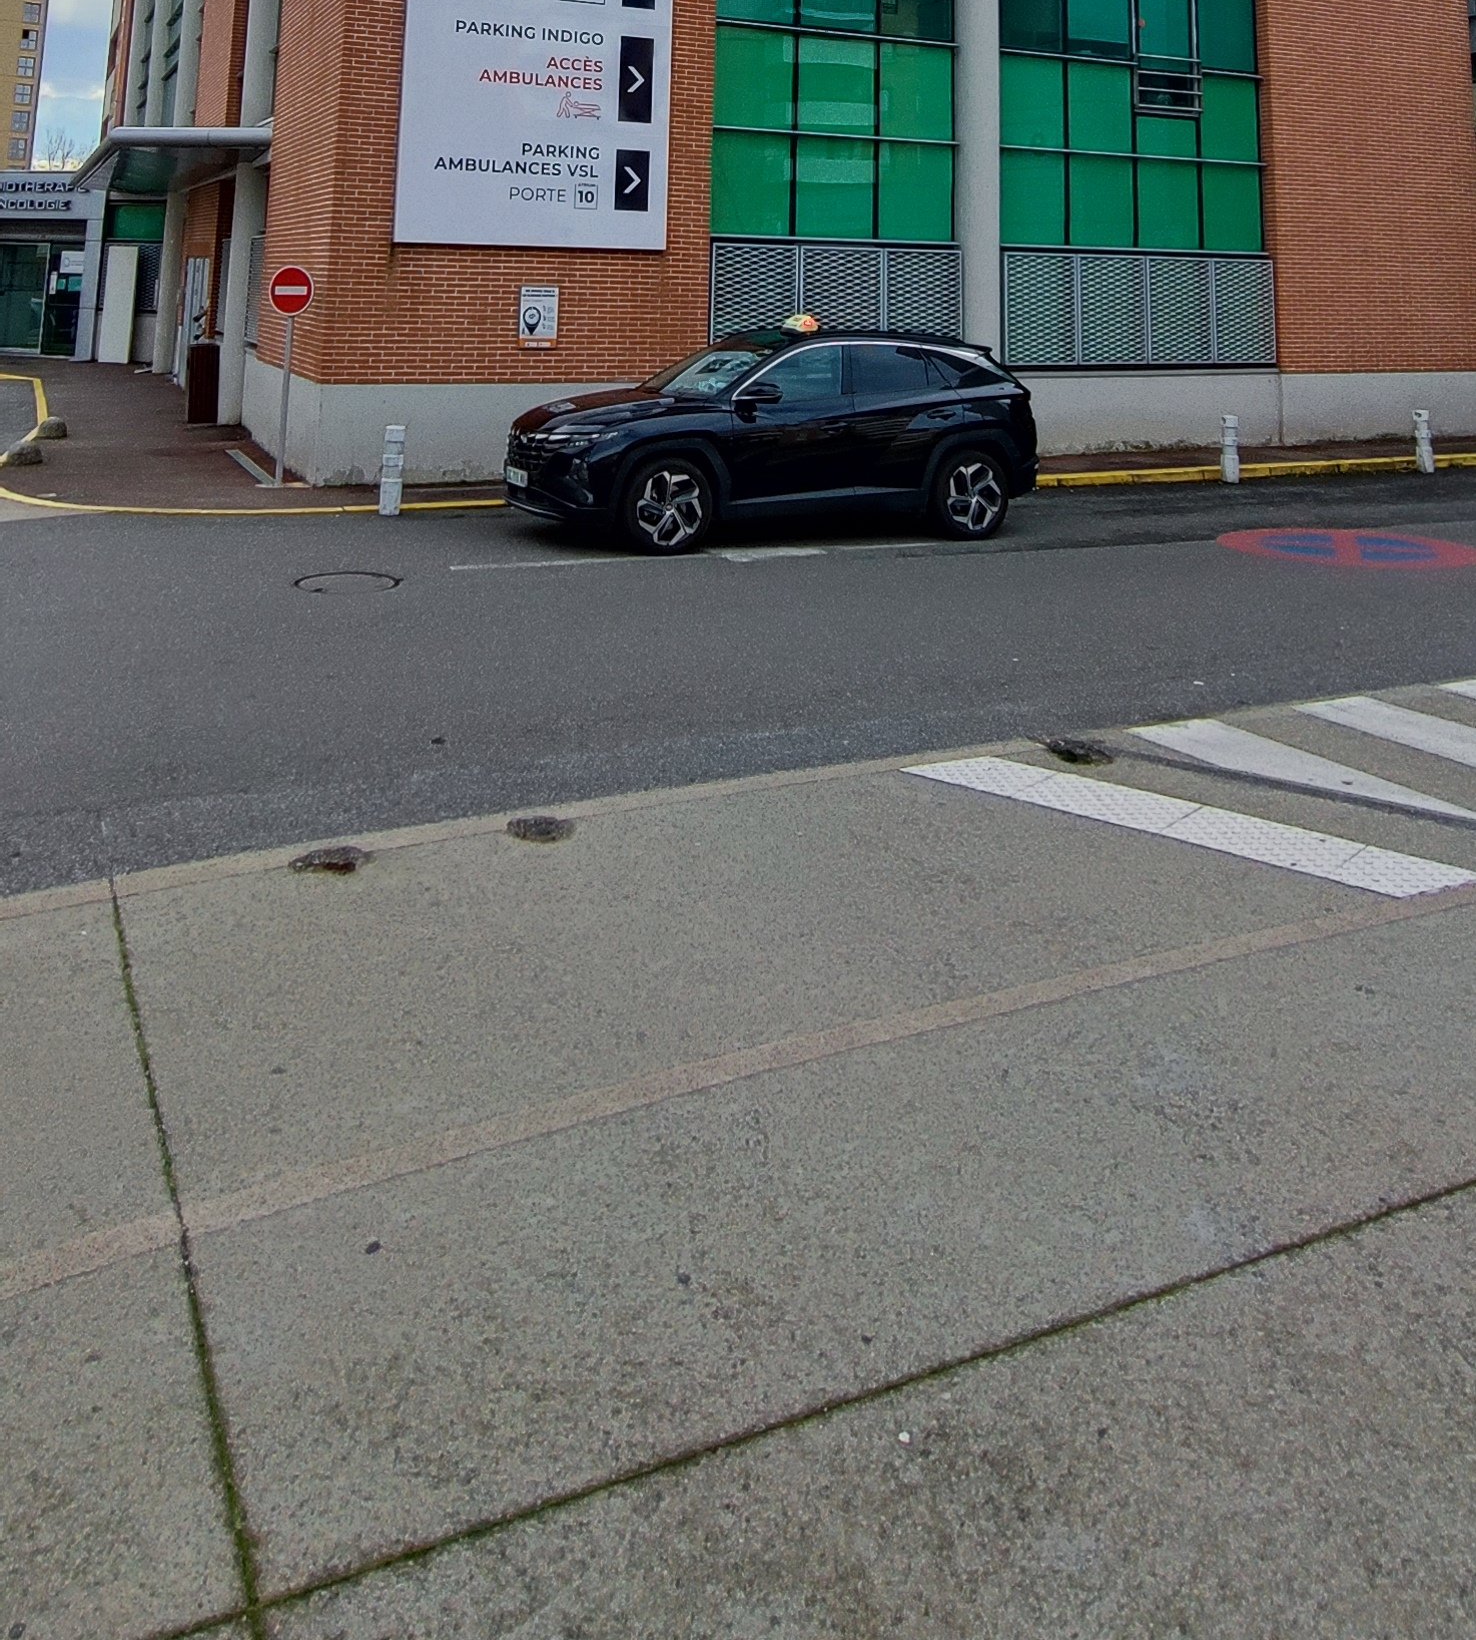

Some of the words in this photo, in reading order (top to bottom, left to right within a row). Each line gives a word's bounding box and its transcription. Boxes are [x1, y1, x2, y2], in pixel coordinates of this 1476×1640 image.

[455, 20, 536, 40] PARKING
[542, 28, 604, 46] INDIGO
[546, 56, 603, 73] ACCÈS
[479, 69, 603, 90] AMBULANCES
[521, 143, 600, 160] PARKING
[434, 157, 562, 176] AMBULANCES
[567, 164, 599, 178] VSL
[509, 187, 567, 203] PORTE
[578, 190, 595, 204] 10
